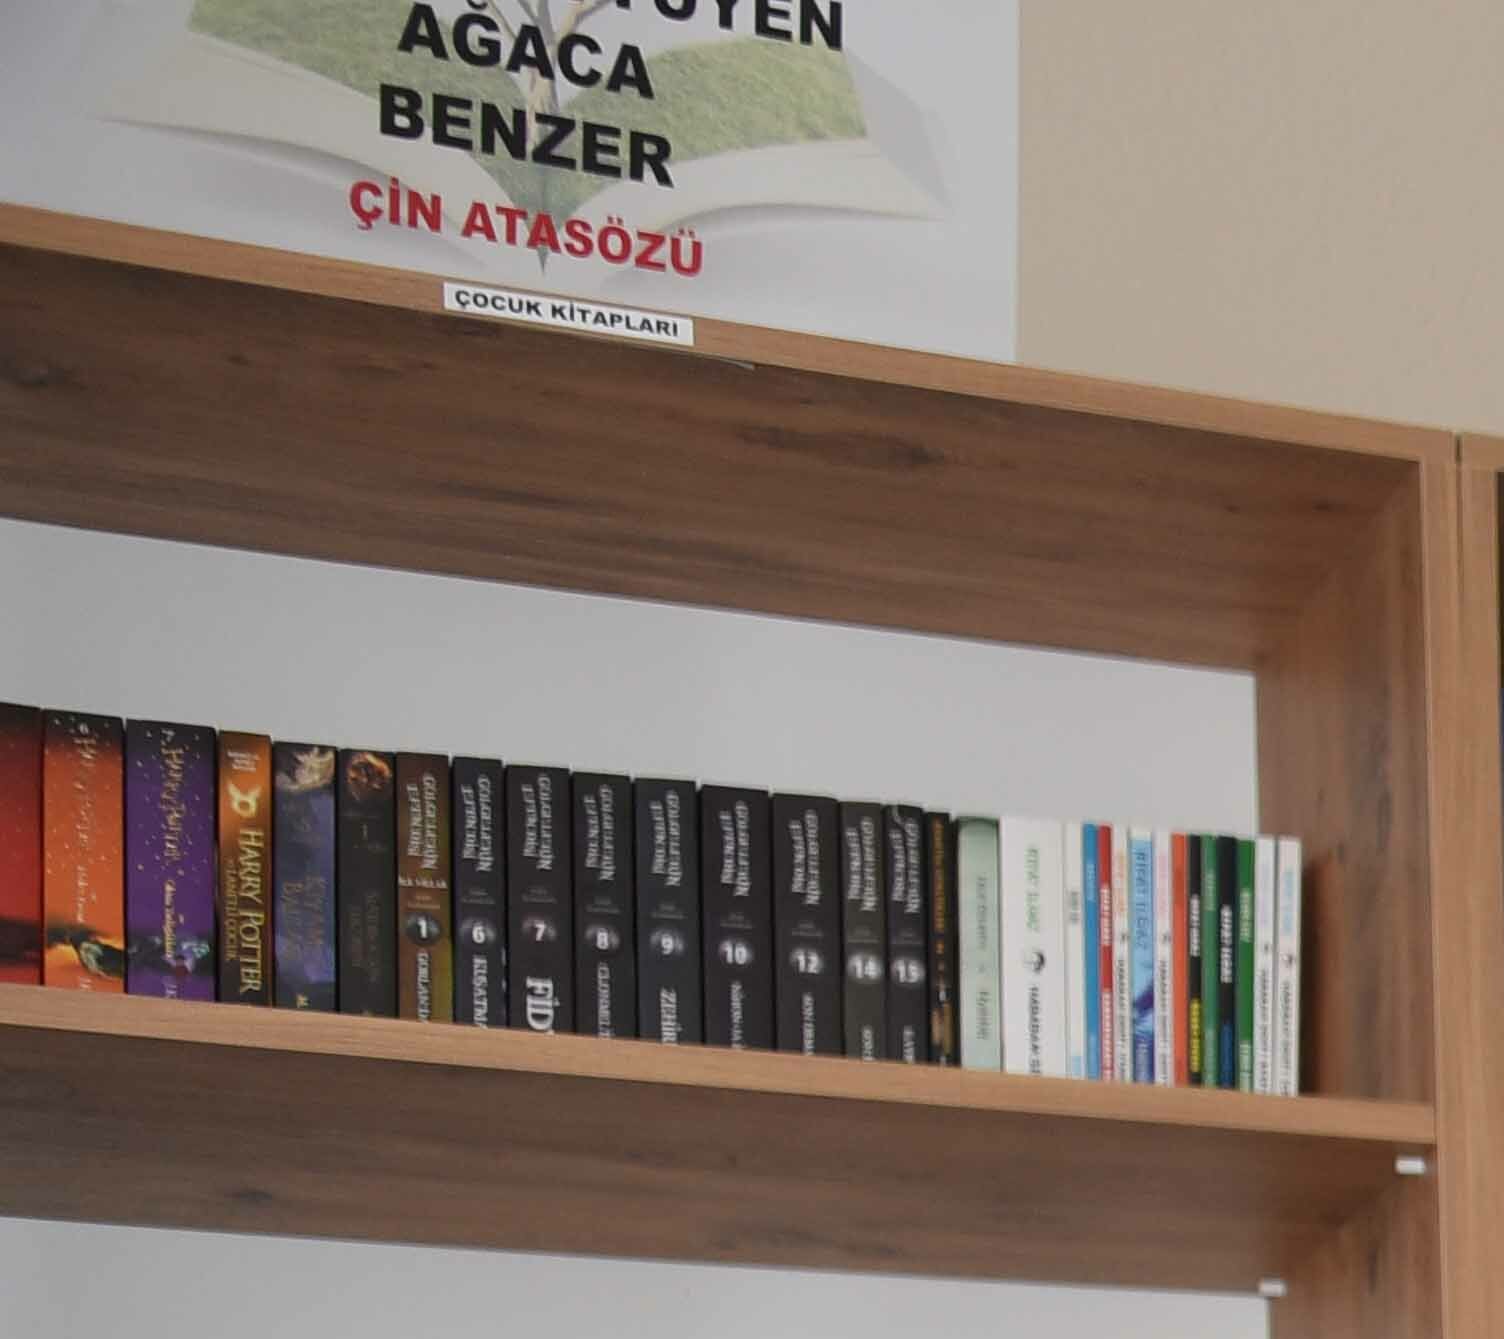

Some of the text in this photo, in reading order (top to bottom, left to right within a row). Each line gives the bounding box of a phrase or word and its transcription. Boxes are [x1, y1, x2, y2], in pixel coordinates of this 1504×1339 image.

[398, 0, 657, 99] AĞACA
[378, 83, 674, 187] BENZER
[348, 176, 705, 278] ÇİN ATASÖZÜ
[454, 288, 680, 338] ÇOCUK KİTAPLARI
[238, 829, 265, 993] HARRY POTTER
